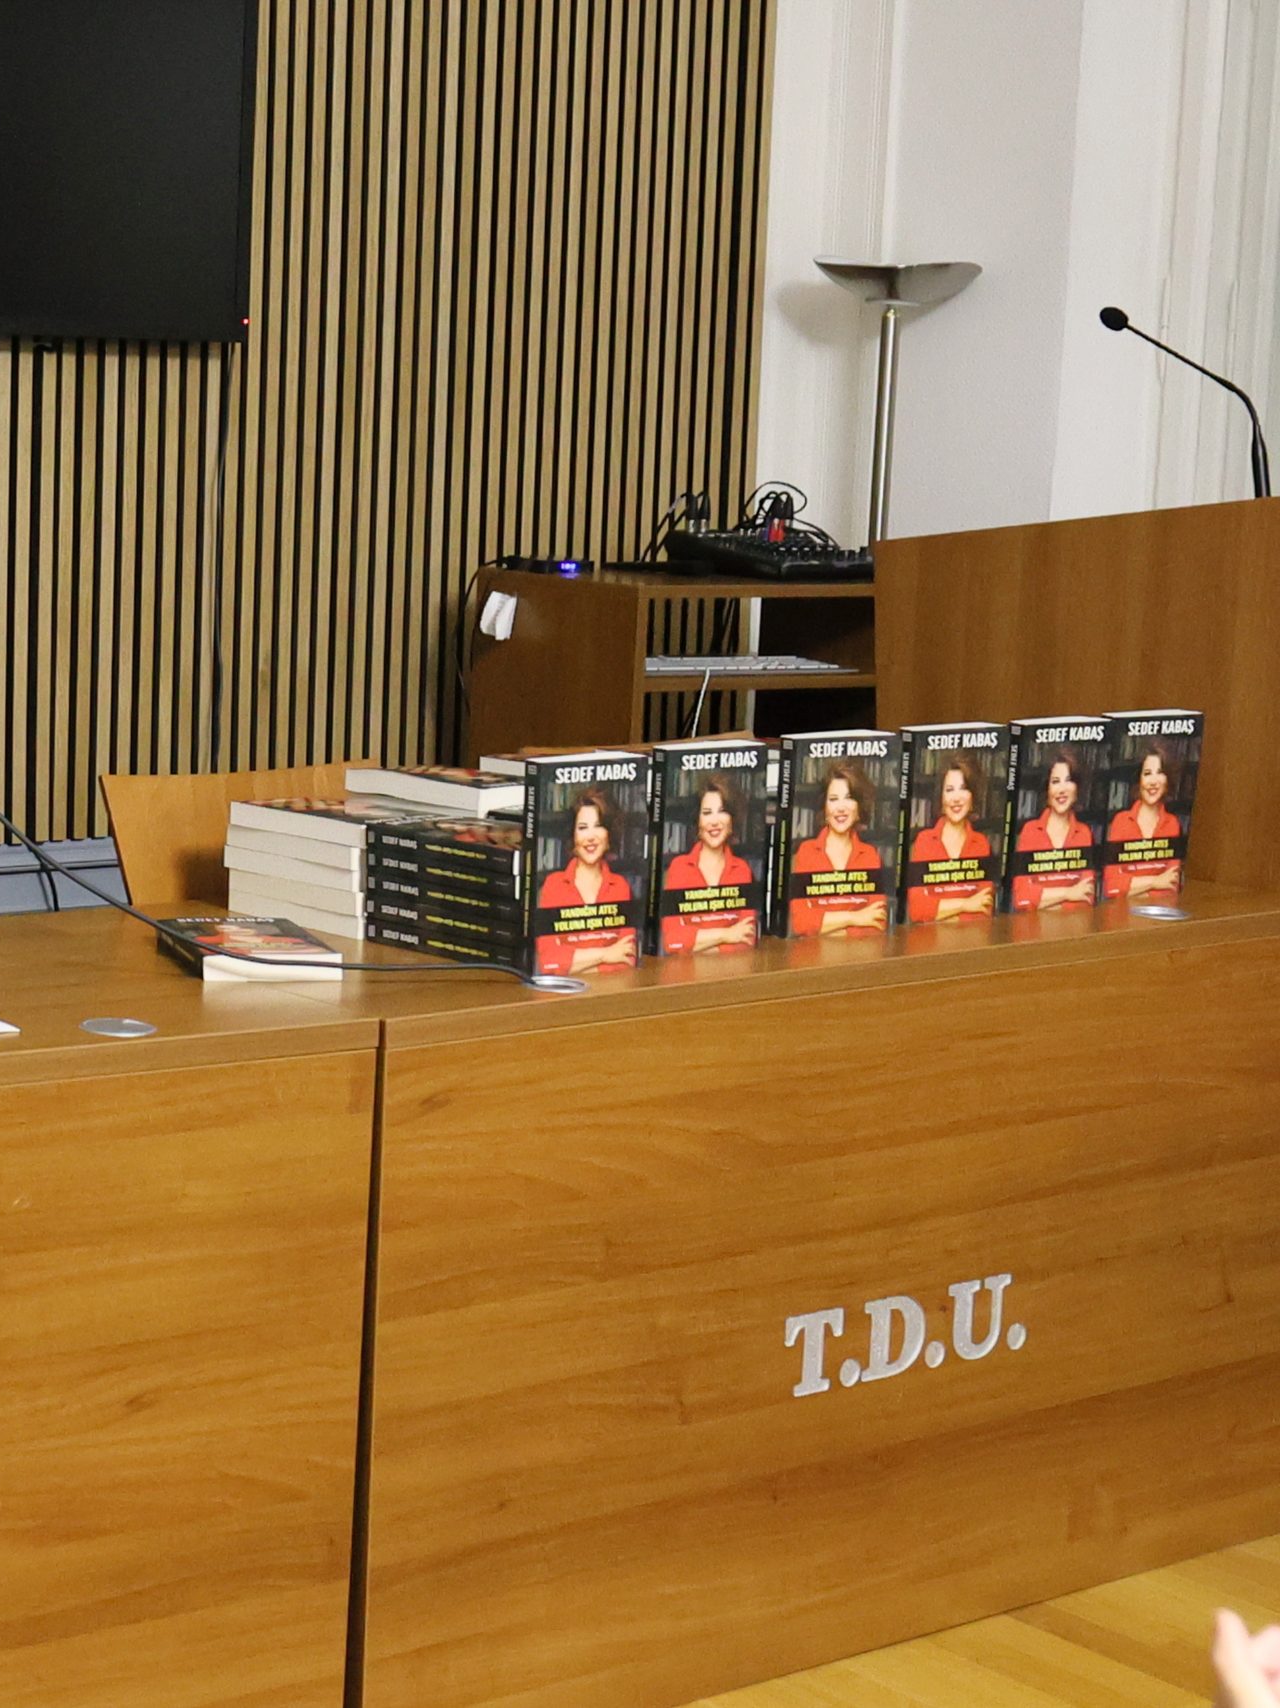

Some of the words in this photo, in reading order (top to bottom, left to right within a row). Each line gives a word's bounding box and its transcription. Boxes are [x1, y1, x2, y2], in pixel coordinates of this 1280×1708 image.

[1035, 728, 1068, 743] SEDEF
[1069, 726, 1105, 742] KABAŞ
[1128, 721, 1159, 736] SEDEF
[1161, 719, 1195, 735] KABAŞ
[809, 742, 845, 758] SEDEF
[847, 740, 888, 758] KABAŞ
[928, 734, 961, 750] SEDEF
[962, 732, 998, 749] KABAŞ
[681, 753, 718, 770] SEDEF
[720, 751, 758, 769] KABAŞ
[555, 766, 594, 784] SEDEF
[596, 763, 637, 781] KABAŞ
[848, 871, 868, 883] ATEŞ
[720, 886, 740, 898] ATEŞ
[806, 884, 835, 895] YOLUNA
[598, 904, 618, 916] ATEŞ
[679, 901, 708, 913] YOLUNA
[553, 919, 586, 932] YOLUNA
[784, 1273, 1027, 1397] T.D.U.
